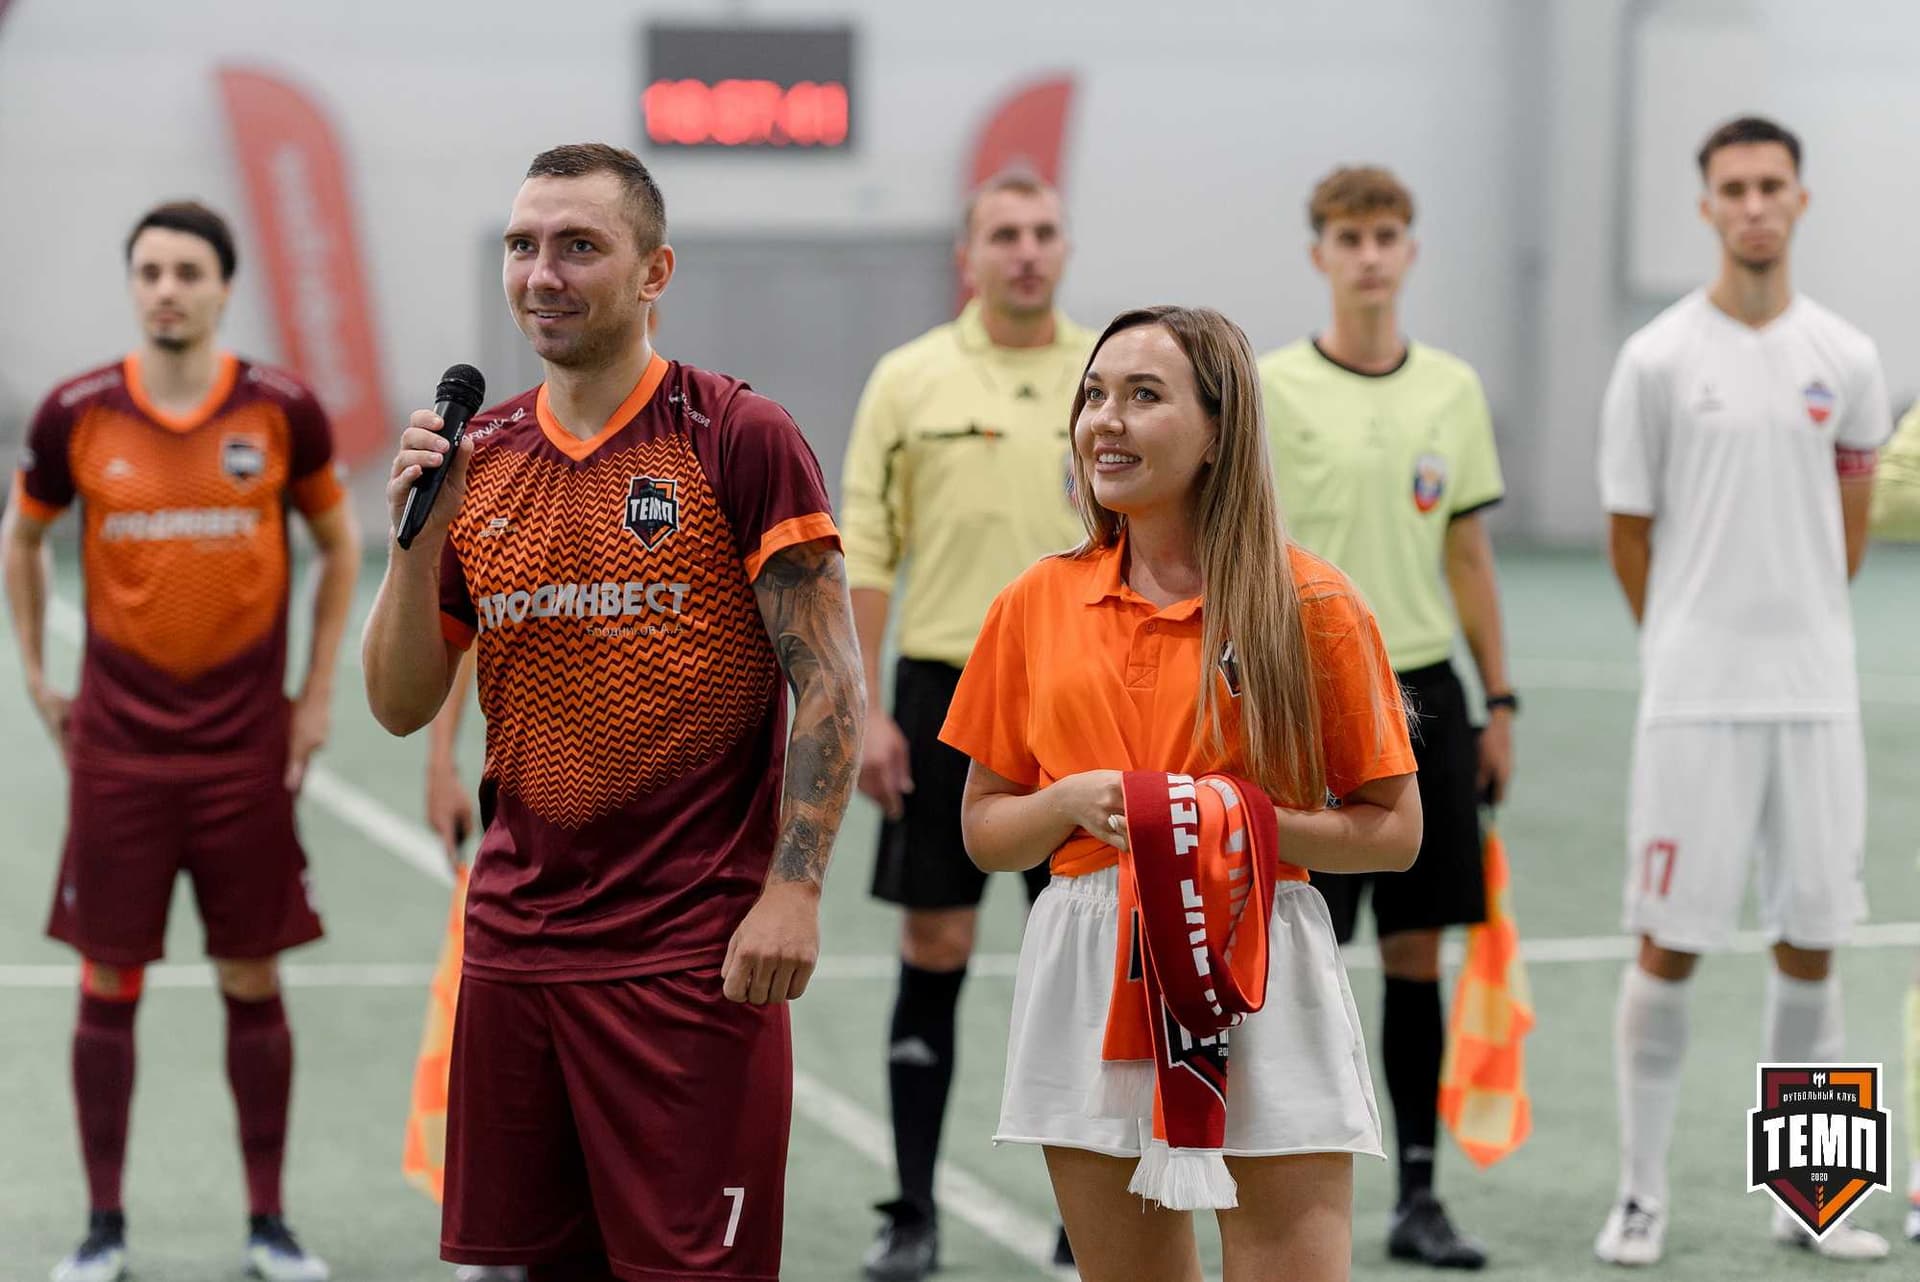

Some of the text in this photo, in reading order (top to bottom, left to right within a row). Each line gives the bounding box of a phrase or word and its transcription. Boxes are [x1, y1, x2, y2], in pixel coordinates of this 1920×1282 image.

[630, 496, 673, 525] ТЕМП
[1643, 840, 1677, 897] 17
[723, 1187, 745, 1247] 7
